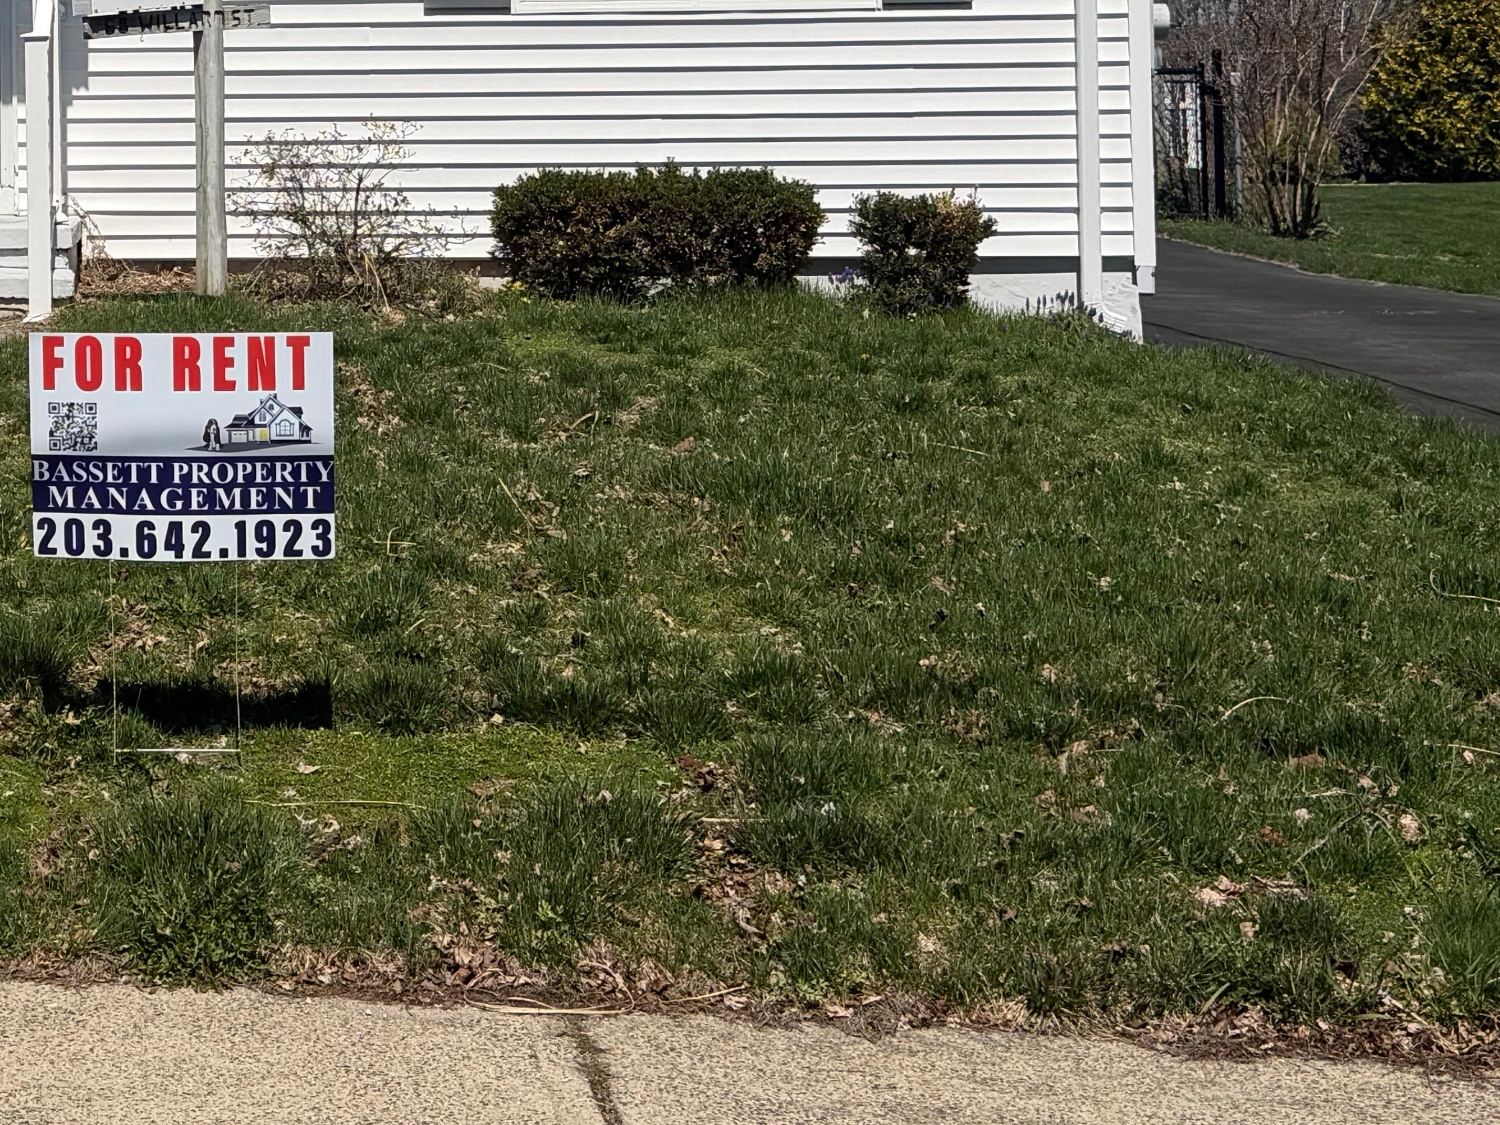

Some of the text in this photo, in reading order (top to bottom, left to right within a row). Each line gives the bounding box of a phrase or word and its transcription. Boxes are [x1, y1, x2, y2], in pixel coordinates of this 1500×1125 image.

[231, 8, 255, 28] ST
[42, 335, 311, 392] FOR RENT
[33, 460, 334, 485] BASSETT PROPERTY
[48, 486, 321, 511] MANAGEMENT
[36, 517, 332, 560] 203.642.1923
